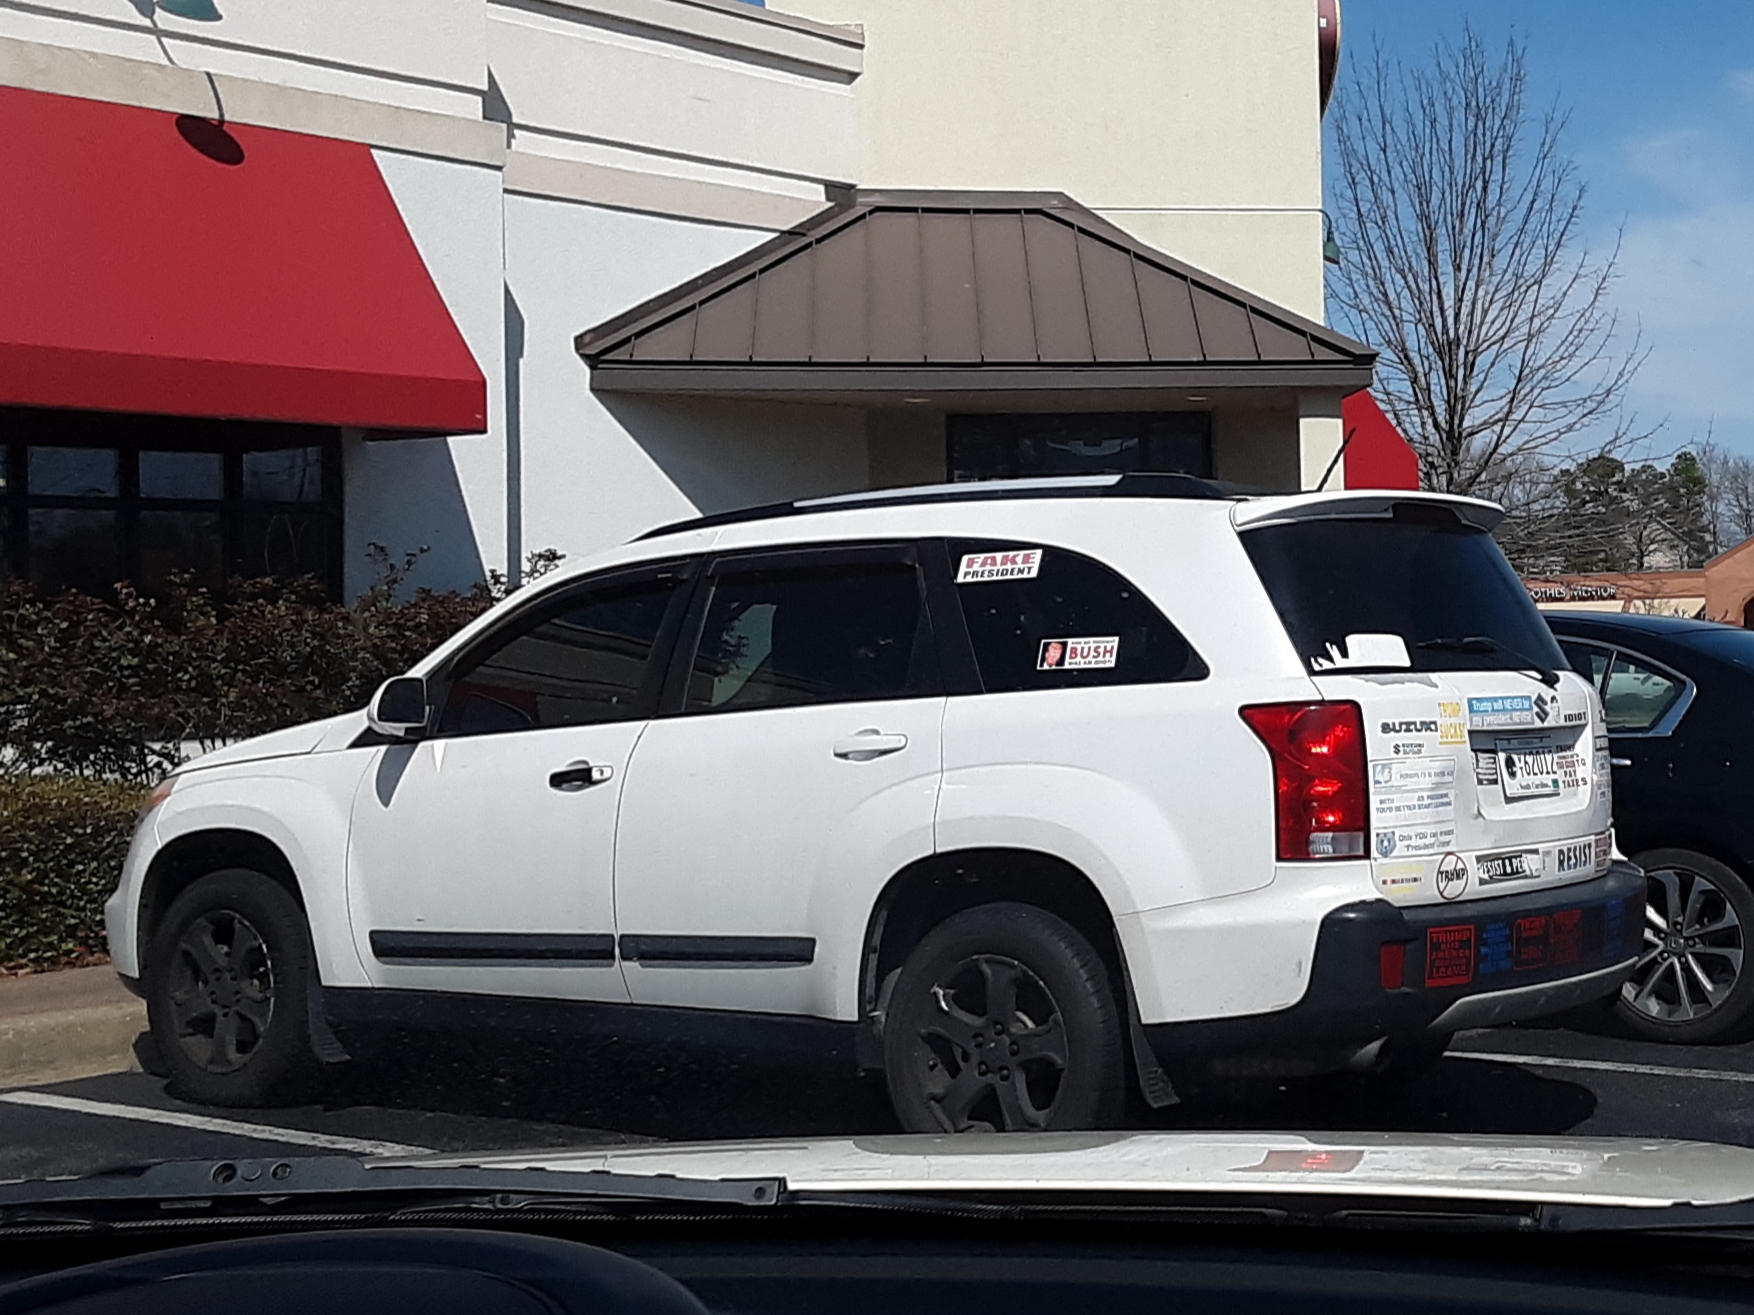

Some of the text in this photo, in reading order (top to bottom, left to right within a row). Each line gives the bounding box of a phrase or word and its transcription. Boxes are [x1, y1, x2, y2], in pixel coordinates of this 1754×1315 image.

[966, 552, 1037, 569] FAKE
[963, 566, 1034, 580] PRESIDENT
[1529, 586, 1566, 599] OTHES
[1068, 645, 1115, 660] BUSH
[1472, 700, 1492, 712] Trump
[1503, 698, 1523, 709] NEVER
[1563, 712, 1587, 723] IDIOT
[1380, 720, 1438, 734] SUZUKI
[1524, 749, 1557, 776] 62012
[1563, 770, 1577, 778] PAY
[1562, 777, 1588, 789] TAXES
[1414, 831, 1428, 840] YOU
[1557, 842, 1592, 873] RESIST
[1440, 867, 1466, 883] TRUMP
[1431, 930, 1470, 943] TRUMP
